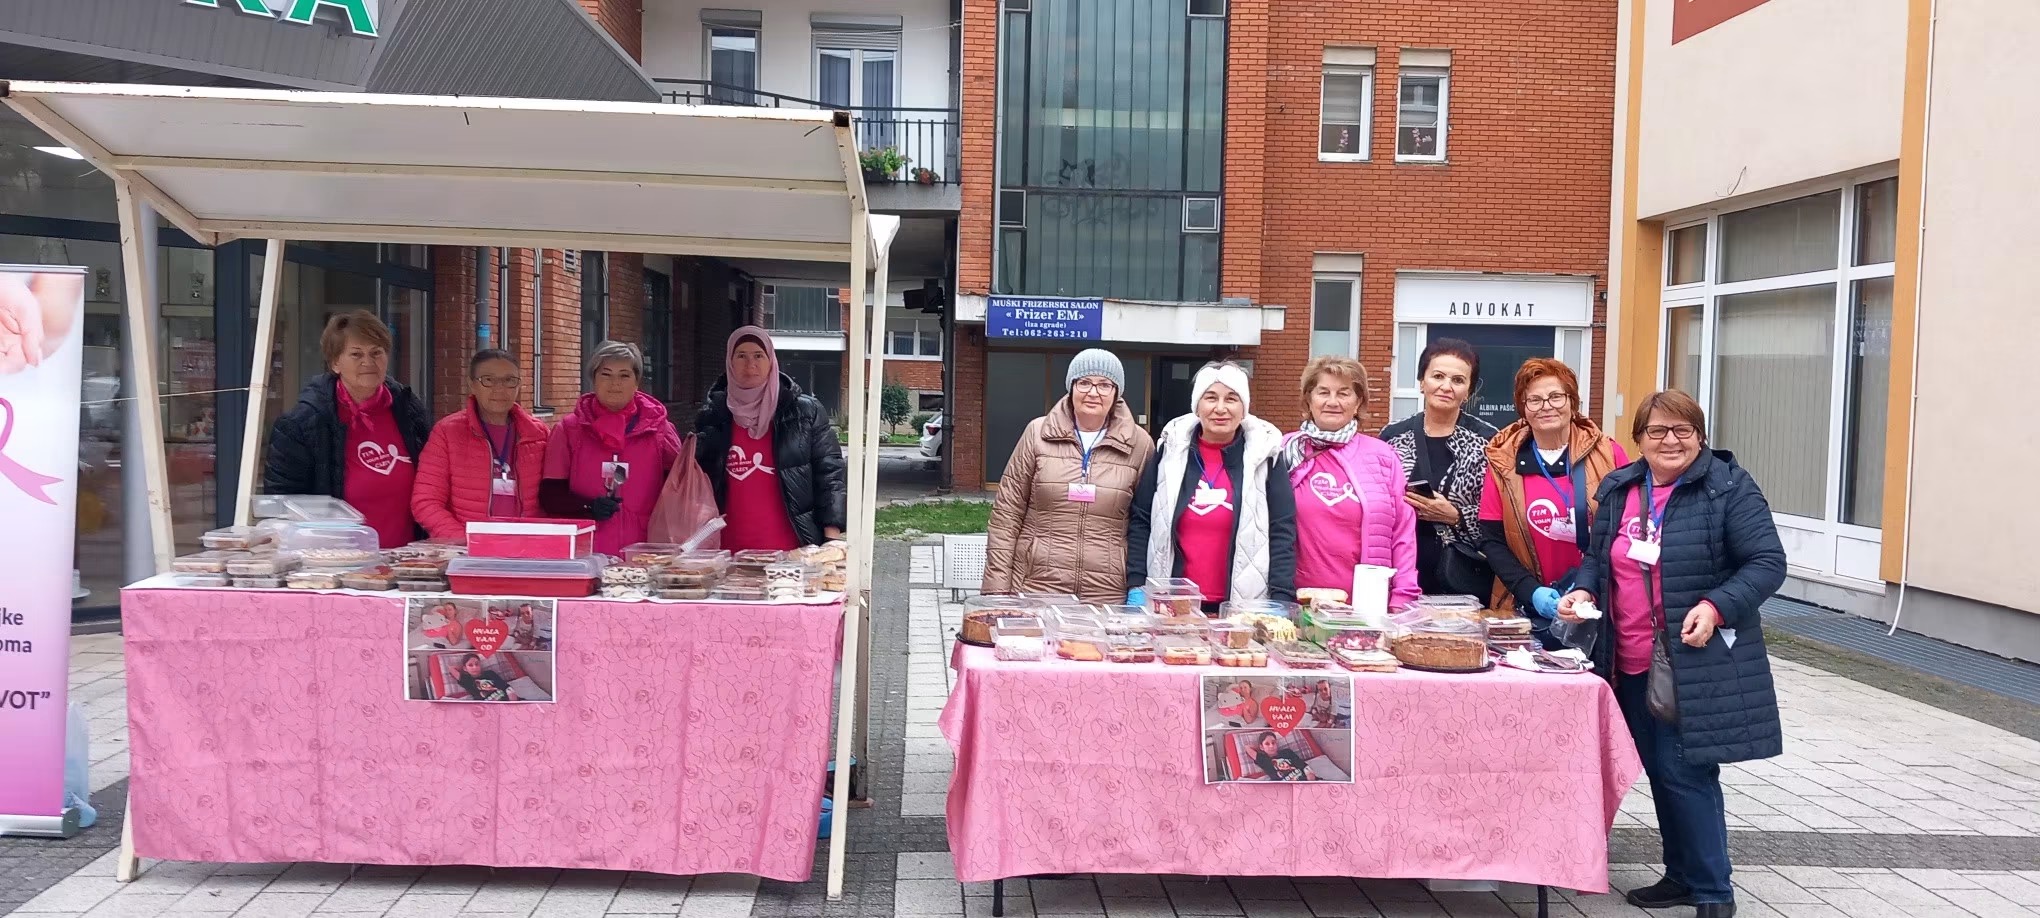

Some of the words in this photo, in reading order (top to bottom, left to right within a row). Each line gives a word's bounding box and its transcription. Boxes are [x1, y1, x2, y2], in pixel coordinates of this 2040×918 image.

[992, 299, 1020, 307] MUŠKI
[1022, 300, 1069, 309] FRIZERSKI
[1070, 301, 1099, 310] SALON
[1449, 301, 1535, 317] ADVOKAT
[1015, 308, 1054, 320] Frizer
[1531, 508, 1547, 517] TIM
[1272, 713, 1293, 721] VAM
[1276, 721, 1290, 729] OD
